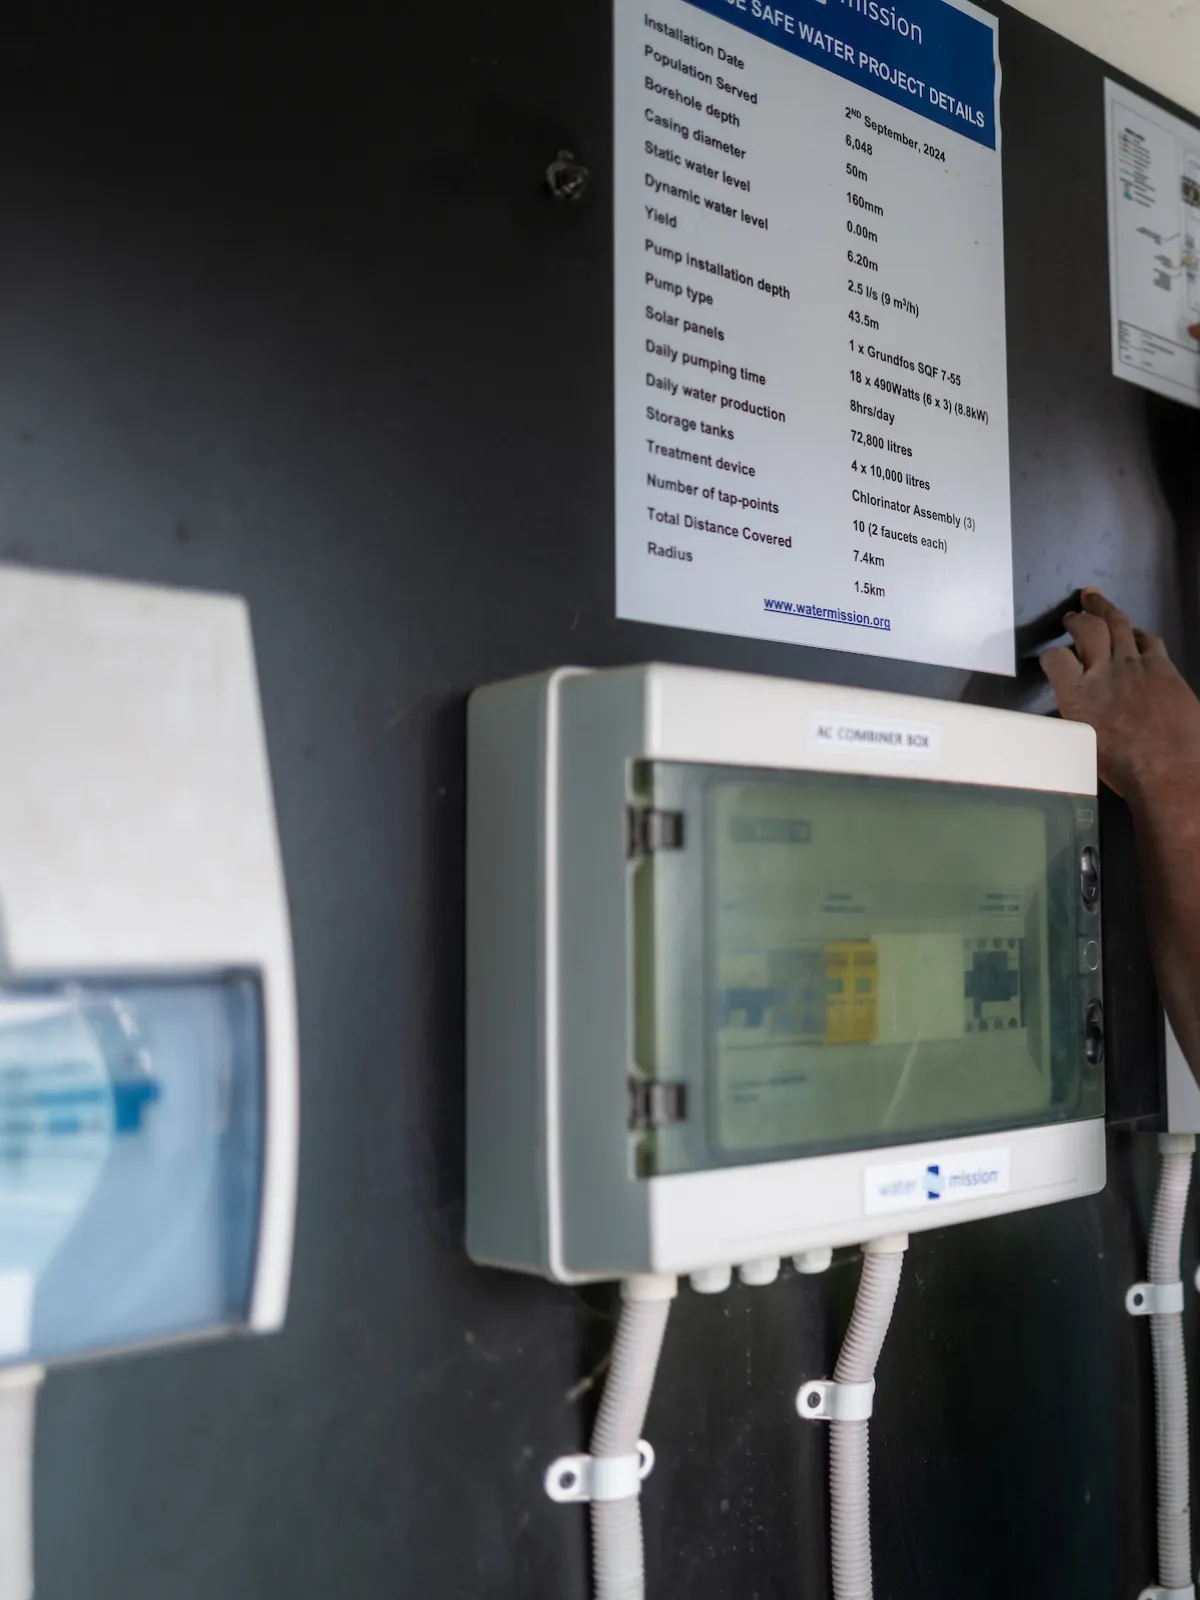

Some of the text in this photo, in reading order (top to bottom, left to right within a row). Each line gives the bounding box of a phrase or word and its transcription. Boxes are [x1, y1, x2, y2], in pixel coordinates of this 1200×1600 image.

[645, 14, 744, 69] Installation Date
[645, 44, 757, 104] Population Served
[752, 0, 984, 127] SAFE WATER PROJECT DETAILS
[645, 76, 740, 127] Borehole depth
[645, 108, 746, 159] Casing diameter
[846, 135, 872, 155] 6,048
[865, 116, 920, 153] September,
[924, 143, 945, 162] 2024
[645, 140, 750, 192] Static water level
[846, 163, 867, 181] 50m
[645, 173, 768, 230] Dynamic water level
[645, 206, 677, 228] Yield
[847, 192, 883, 216] 160mm
[847, 221, 877, 242] 0.00m
[645, 239, 790, 299] Pump installation depth
[848, 250, 878, 271] 6.20m
[645, 272, 713, 305] Pump type
[848, 280, 863, 295] 2.5
[866, 286, 878, 300] l/s
[882, 292, 890, 306] (9
[645, 305, 724, 341] Solar panels
[848, 310, 879, 330] 43.5m
[646, 339, 766, 385] Daily pumping time
[849, 340, 961, 386] 1 x Grundfos SQF 7-55
[646, 373, 785, 422] Daily water production
[850, 370, 988, 425] 18 x 490Watts (6 x 3) (8.8kW)
[850, 400, 894, 425] 8hrs/day
[646, 406, 734, 440] Storage tanks
[646, 439, 755, 477] Treatment device
[851, 430, 912, 457] 72,800 litres
[851, 460, 930, 490] 4 x 10,000 litres
[647, 473, 779, 513] Number of tap-points
[647, 507, 791, 548] Total Distance Covered
[852, 490, 975, 532] Chlorinator Assembly (3)
[648, 542, 693, 562] Radius
[853, 520, 947, 553] 10 (2 faucets each)
[854, 550, 884, 567] 7.4km
[855, 581, 885, 596] 1.5km
[764, 599, 891, 631] www.watermission.org
[817, 725, 929, 748] AC COMBINER BOX
[877, 1168, 999, 1197] water mission
